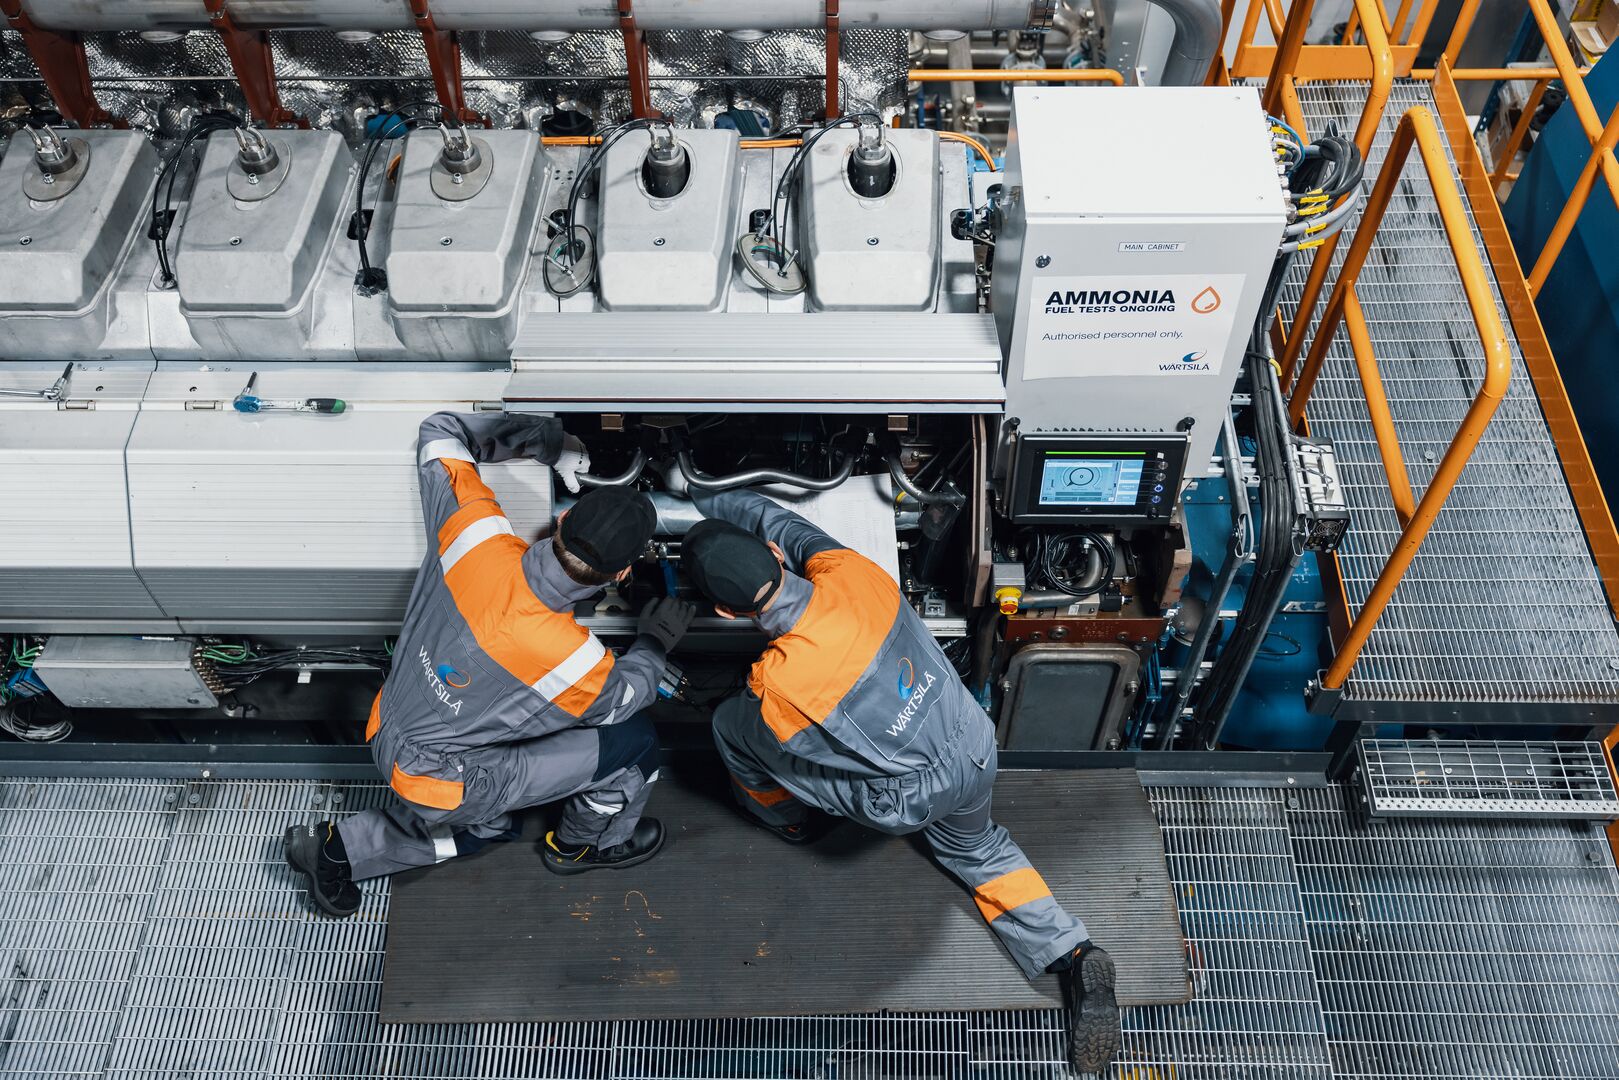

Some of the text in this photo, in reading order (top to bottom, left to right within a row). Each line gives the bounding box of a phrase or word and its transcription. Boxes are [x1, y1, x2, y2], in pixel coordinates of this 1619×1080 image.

[1045, 290, 1176, 306] AMMONIA
[1045, 305, 1176, 314] FUEL TESTS ONGOING
[1042, 331, 1184, 341] Authorised personnel only.
[885, 670, 937, 737] WÄRTSILÄ
